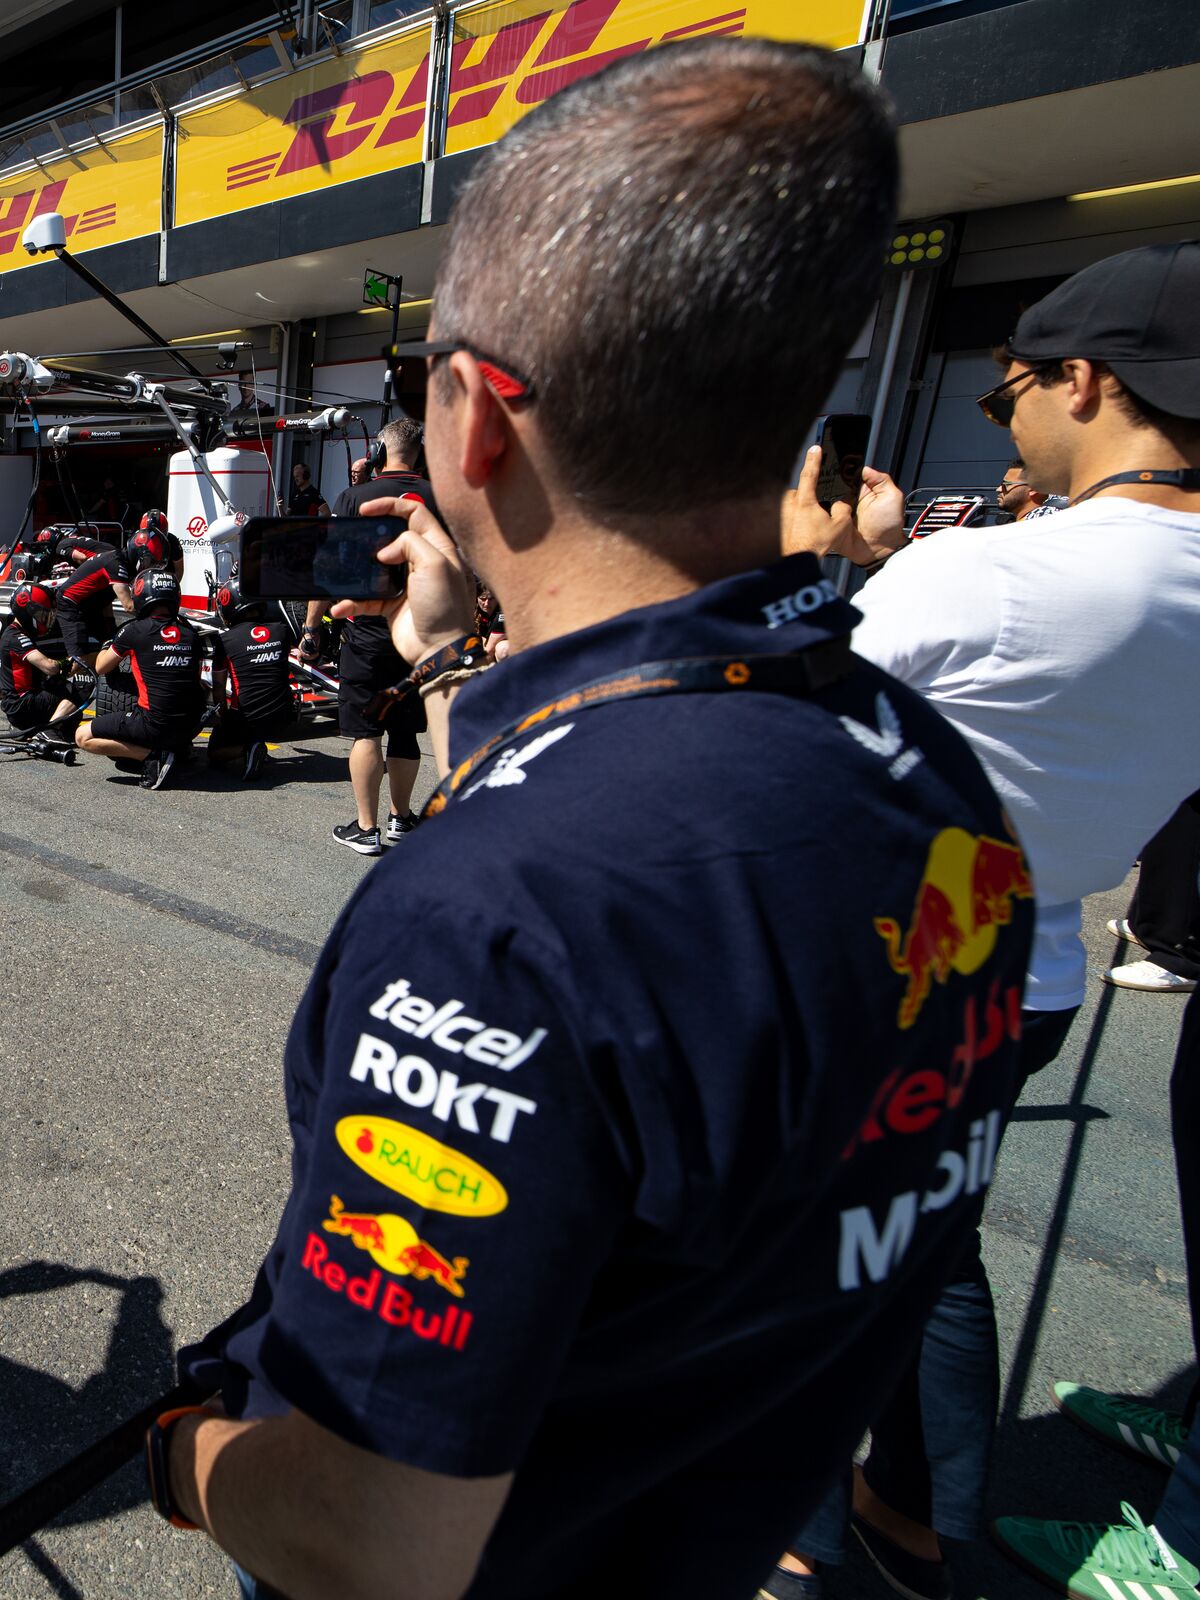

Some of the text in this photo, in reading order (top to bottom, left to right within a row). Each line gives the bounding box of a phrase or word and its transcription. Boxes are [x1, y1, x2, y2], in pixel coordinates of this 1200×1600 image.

[275, 0, 653, 177] DHL
[178, 538, 218, 548] oneyGram
[152, 573, 173, 582] Palm
[760, 578, 838, 630] HON
[153, 644, 192, 652] MoneyGram
[156, 656, 192, 666] HAAS
[246, 640, 282, 651] MoneyGram
[250, 650, 282, 664] HAAS
[369, 978, 549, 1072] telcel
[349, 1033, 538, 1144] ROKT
[378, 1138, 483, 1205] RAUCH
[838, 1109, 1002, 1292] Mil
[301, 1232, 474, 1352] Red Bull
